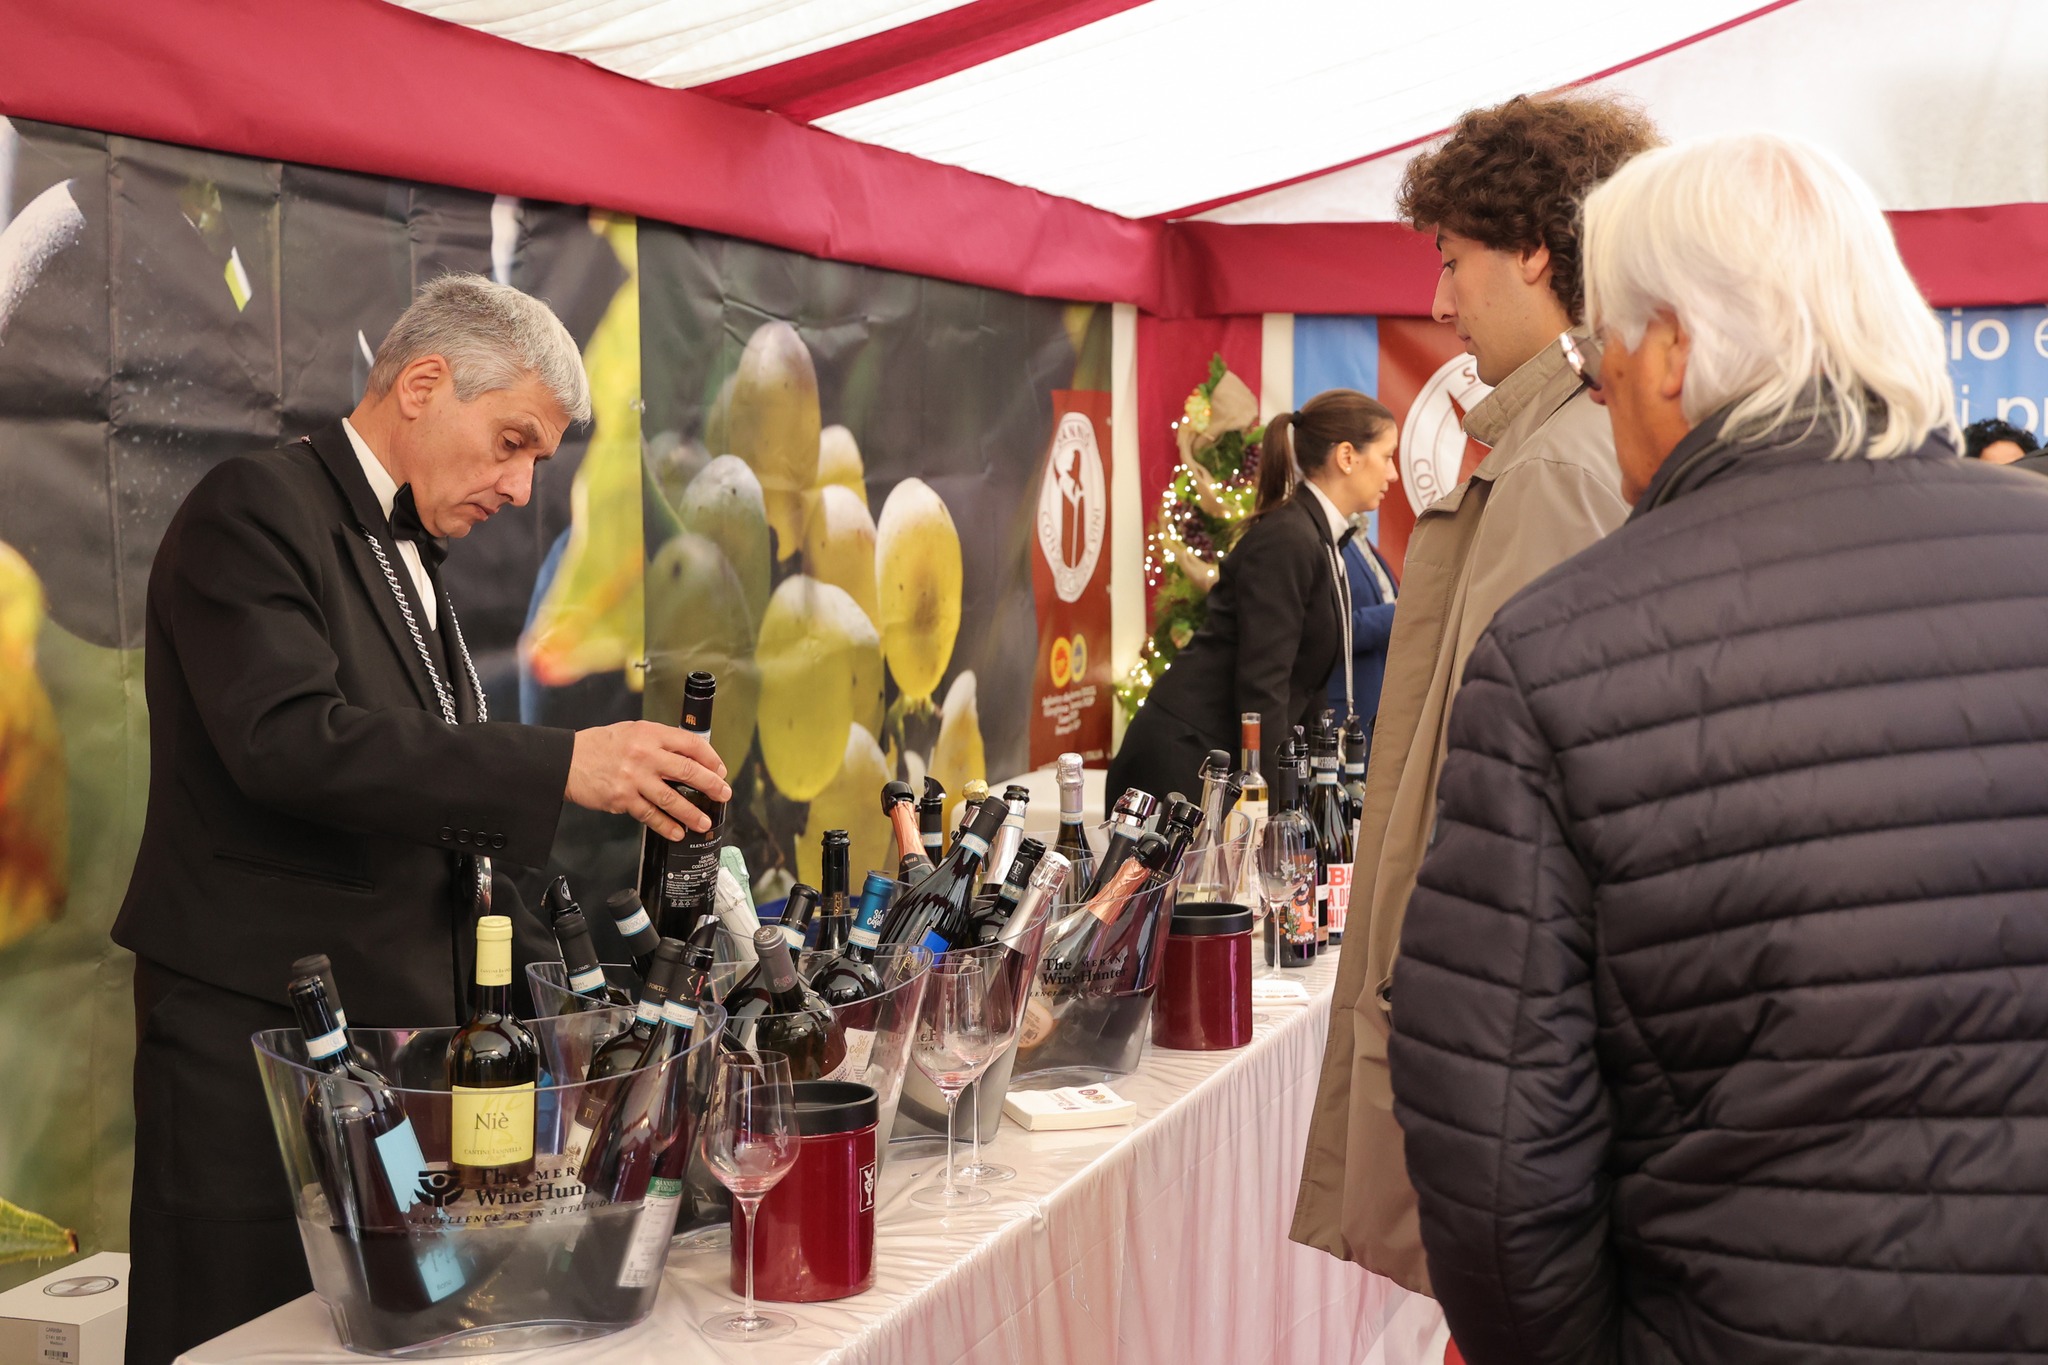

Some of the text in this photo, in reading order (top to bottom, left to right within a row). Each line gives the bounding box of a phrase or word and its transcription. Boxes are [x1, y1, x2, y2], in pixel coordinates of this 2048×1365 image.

[1463, 367, 1476, 385] S
[1043, 958, 1072, 971] The
[1042, 968, 1128, 985] WineHunter
[474, 1111, 509, 1130] Niè
[480, 1167, 520, 1185] The
[475, 1181, 591, 1206] WineHunt
[527, 1209, 545, 1218] AN
